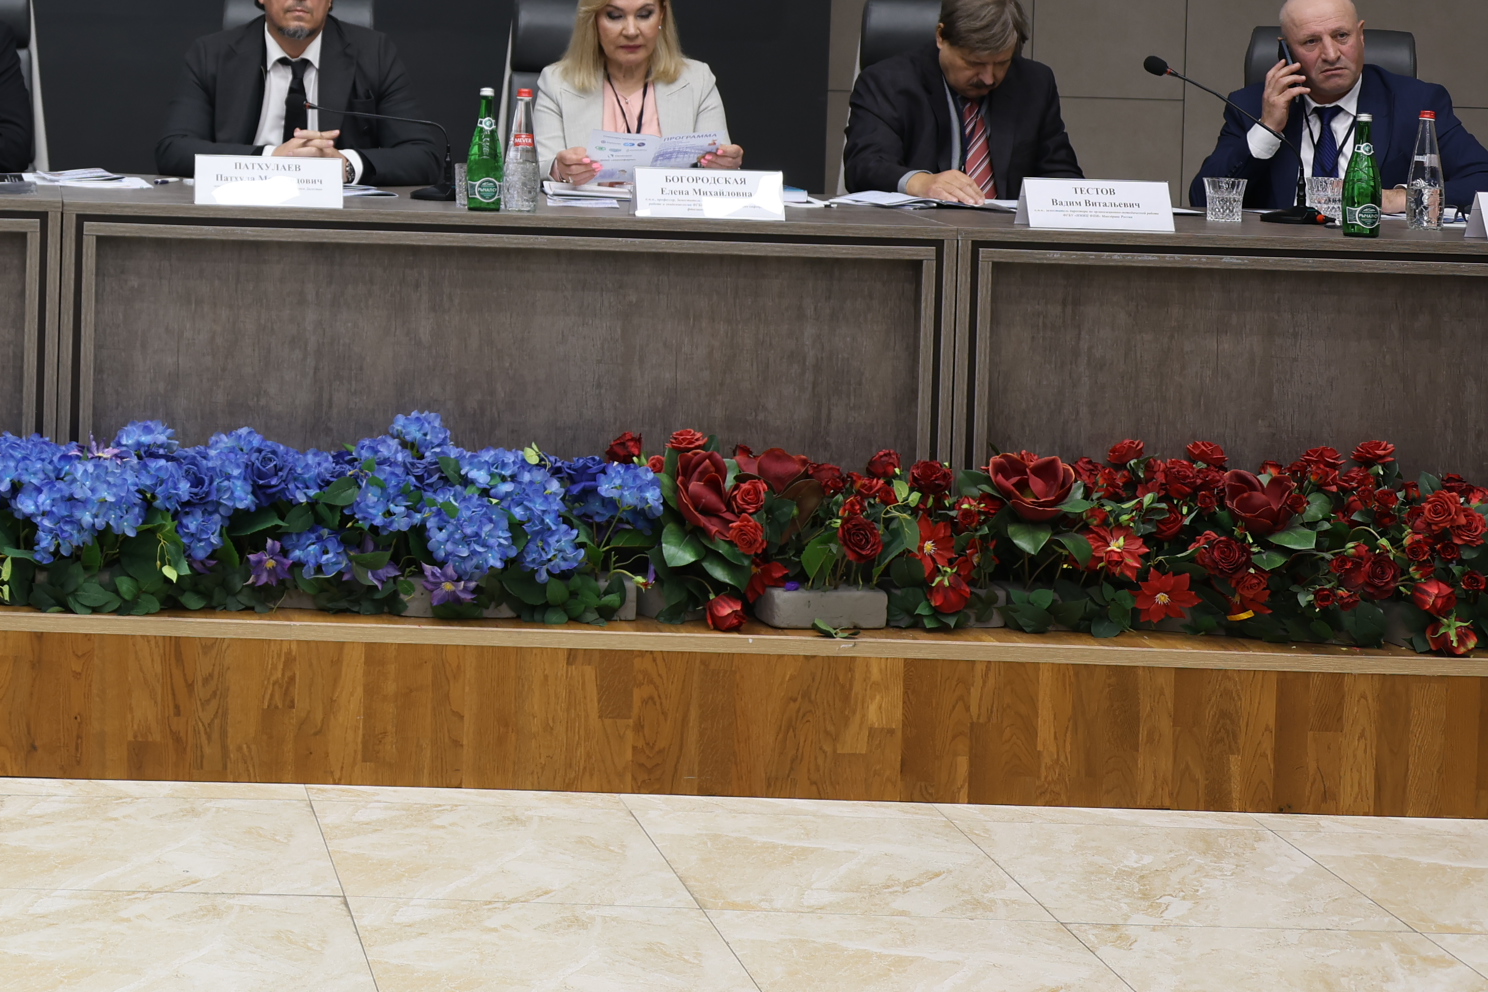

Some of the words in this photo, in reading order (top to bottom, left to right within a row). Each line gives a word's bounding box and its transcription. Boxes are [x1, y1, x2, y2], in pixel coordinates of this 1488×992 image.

[234, 161, 302, 172] ПАТХУЛАЕВ
[665, 175, 747, 186] БОГОРОДСКАЯ
[660, 187, 690, 196] Елена
[692, 188, 753, 198] Михайловна
[1072, 186, 1116, 196] ТЕСТОВ
[1051, 198, 1082, 207] Вадим
[1084, 199, 1141, 209] Витальевич
